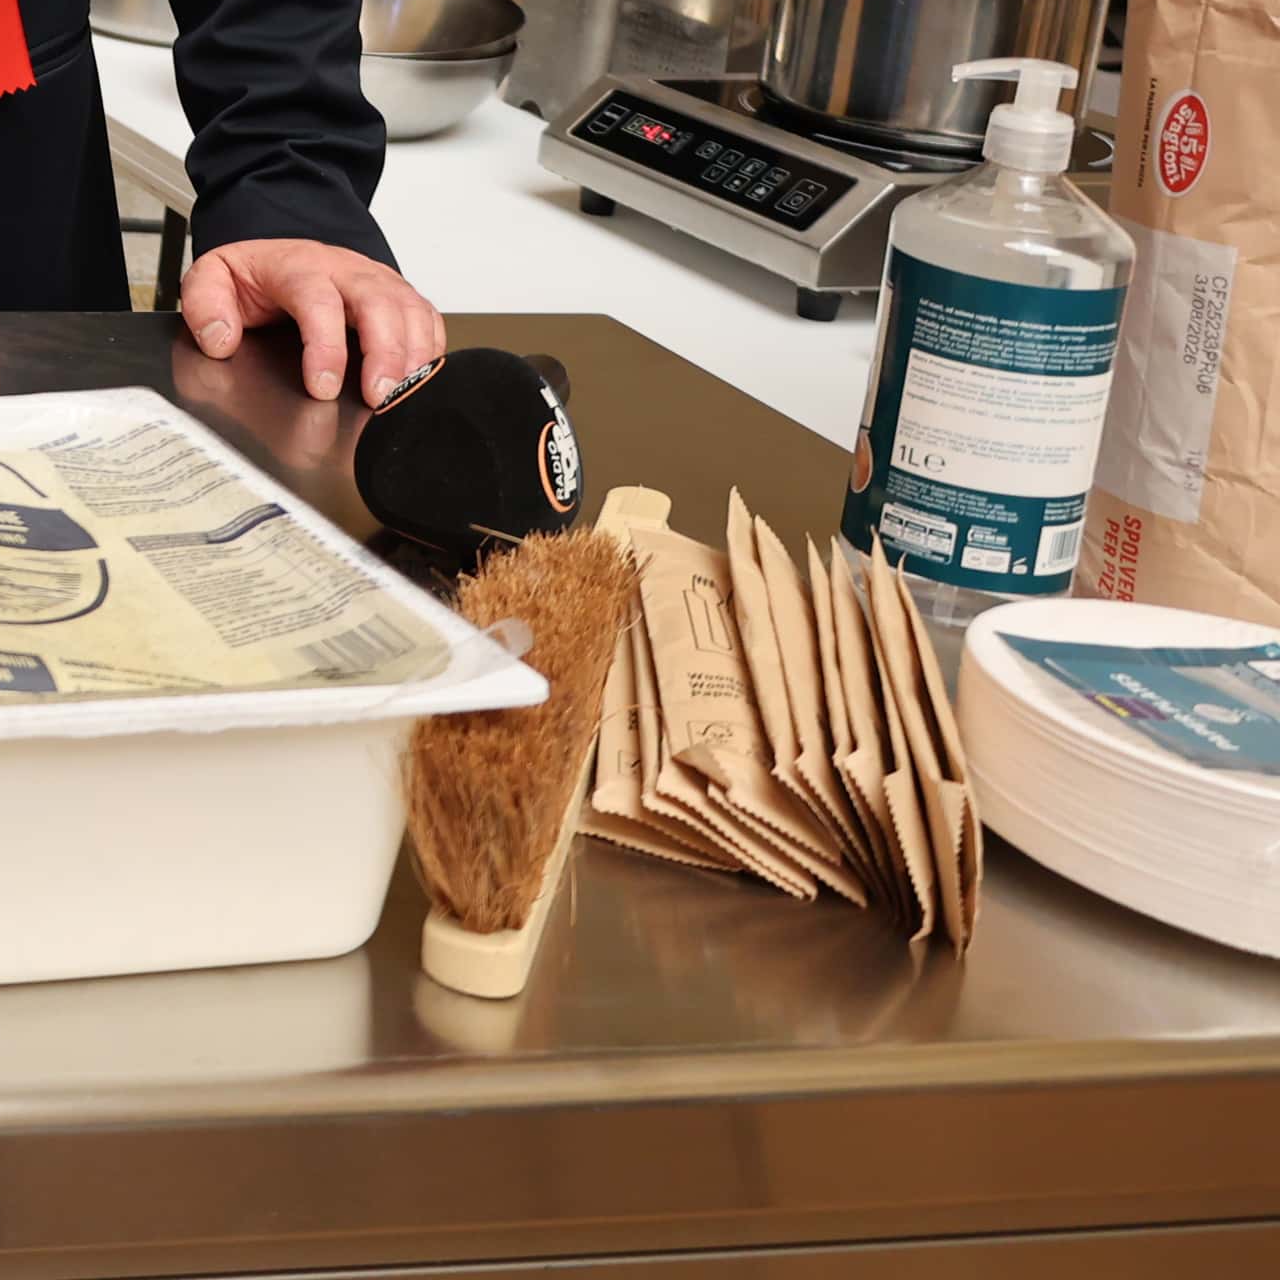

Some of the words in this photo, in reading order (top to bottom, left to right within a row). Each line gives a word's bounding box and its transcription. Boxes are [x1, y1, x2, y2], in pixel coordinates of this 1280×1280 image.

[1183, 274, 1209, 365] 31/08/2026
[548, 440, 565, 501] RADIO
[898, 445, 920, 467] 1L
[1104, 517, 1121, 557] PER
